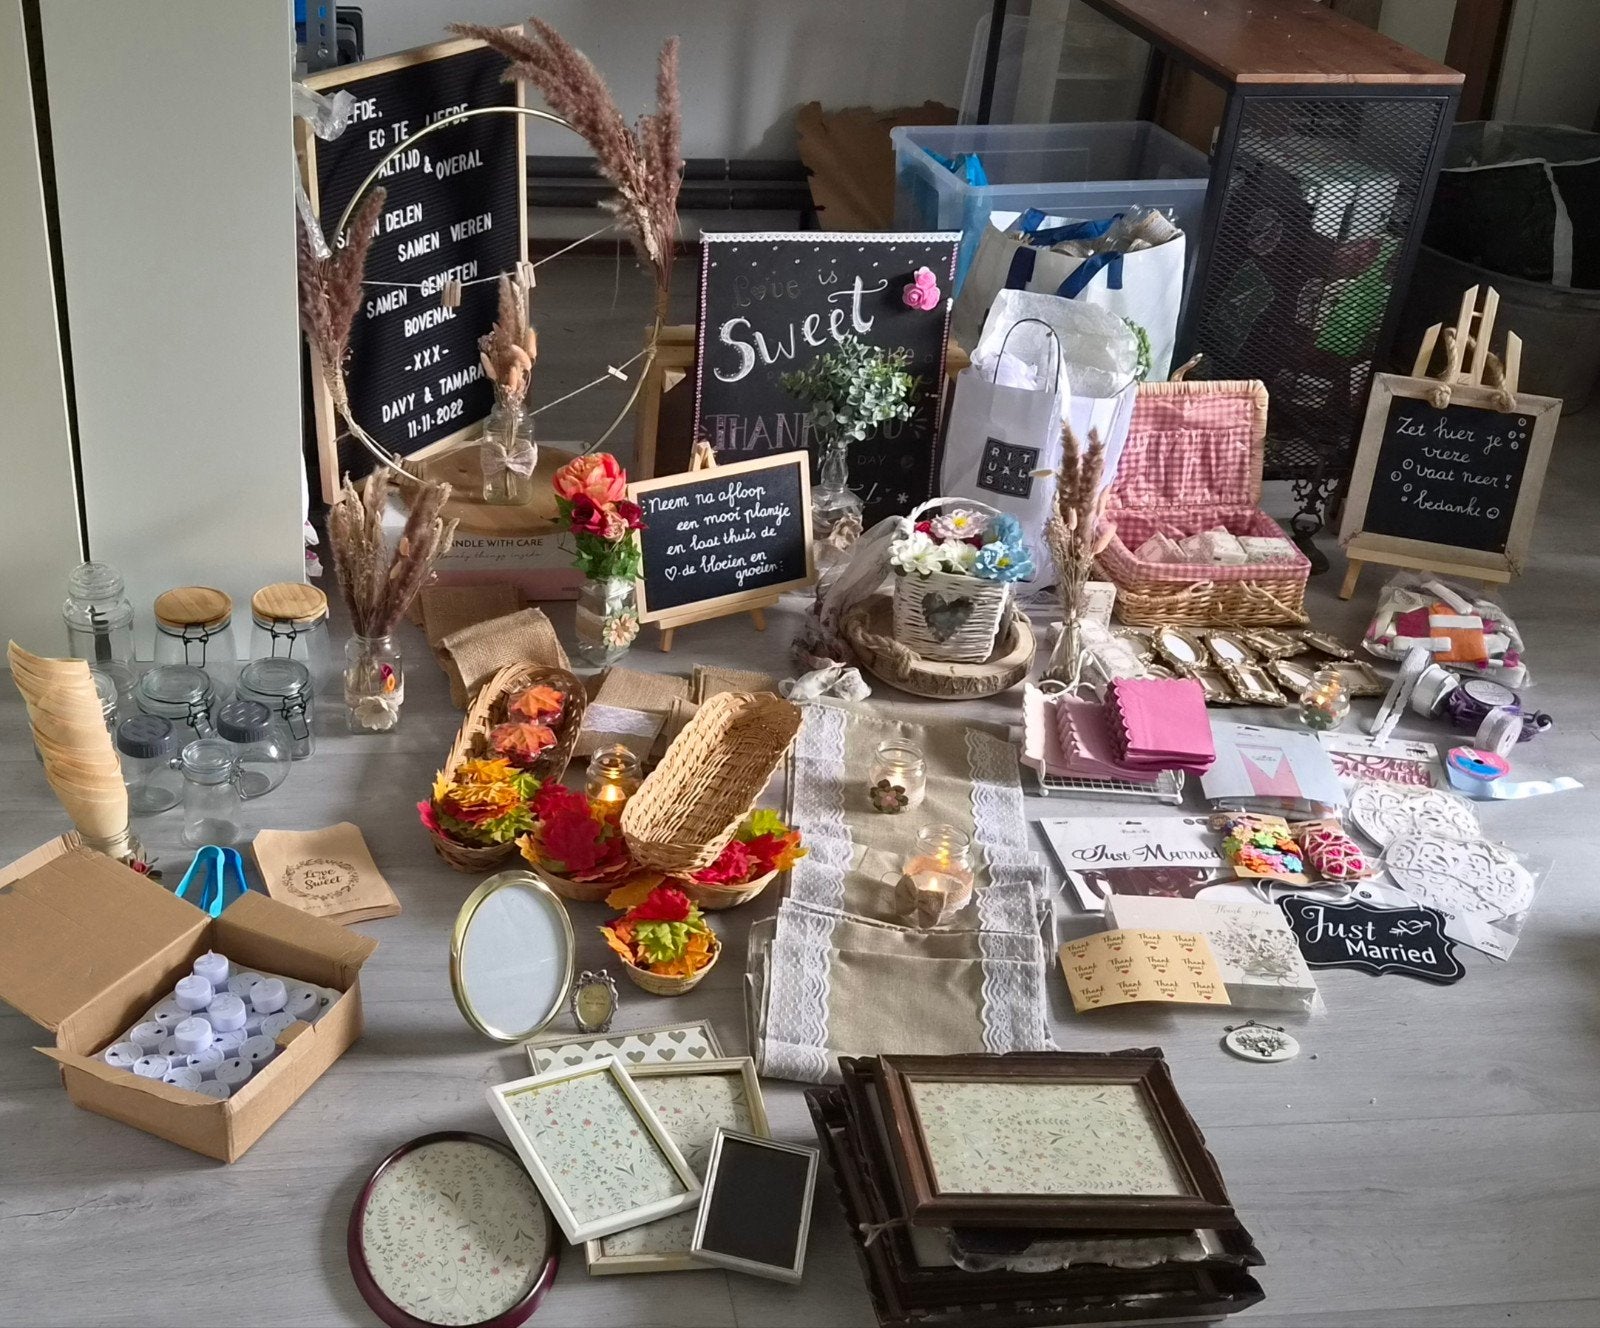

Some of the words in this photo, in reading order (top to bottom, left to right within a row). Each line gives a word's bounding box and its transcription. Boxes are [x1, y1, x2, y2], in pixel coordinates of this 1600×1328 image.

[391, 120, 409, 144] TE
[378, 148, 420, 179] ALTIJD
[423, 155, 433, 174] &
[436, 149, 484, 181] OVERAL
[385, 202, 423, 233] DELEN
[397, 231, 440, 262] SAMEN
[450, 212, 493, 243] VIEREN
[818, 268, 838, 285] is
[366, 287, 408, 320] SAMEN
[404, 306, 457, 338] BOVENAL
[713, 275, 888, 382] Sweet
[381, 392, 416, 424] DAVY
[423, 386, 434, 404] &
[438, 362, 485, 396] TAMARA
[1396, 416, 1426, 436] Zet
[1433, 416, 1475, 442] hier
[1483, 435, 1503, 456] je
[1416, 464, 1455, 481] vaat
[649, 495, 689, 513] Neem
[695, 491, 715, 505] na
[719, 481, 766, 507] afloop
[1413, 490, 1481, 517] bedankt
[676, 520, 699, 531] een
[703, 506, 741, 525] mooi
[486, 539, 514, 548] WITH
[516, 538, 544, 547] CARE
[666, 542, 686, 556] en
[690, 534, 720, 551] laat
[723, 528, 757, 545] thuis
[761, 526, 777, 538] de
[700, 554, 747, 573] bloeien
[750, 551, 767, 564] en
[735, 561, 778, 587] groeien
[1072, 844, 1130, 862] Just
[303, 869, 336, 879] Love
[304, 876, 342, 890] Sweet
[1301, 905, 1377, 944] Just
[1344, 938, 1437, 965] Married
